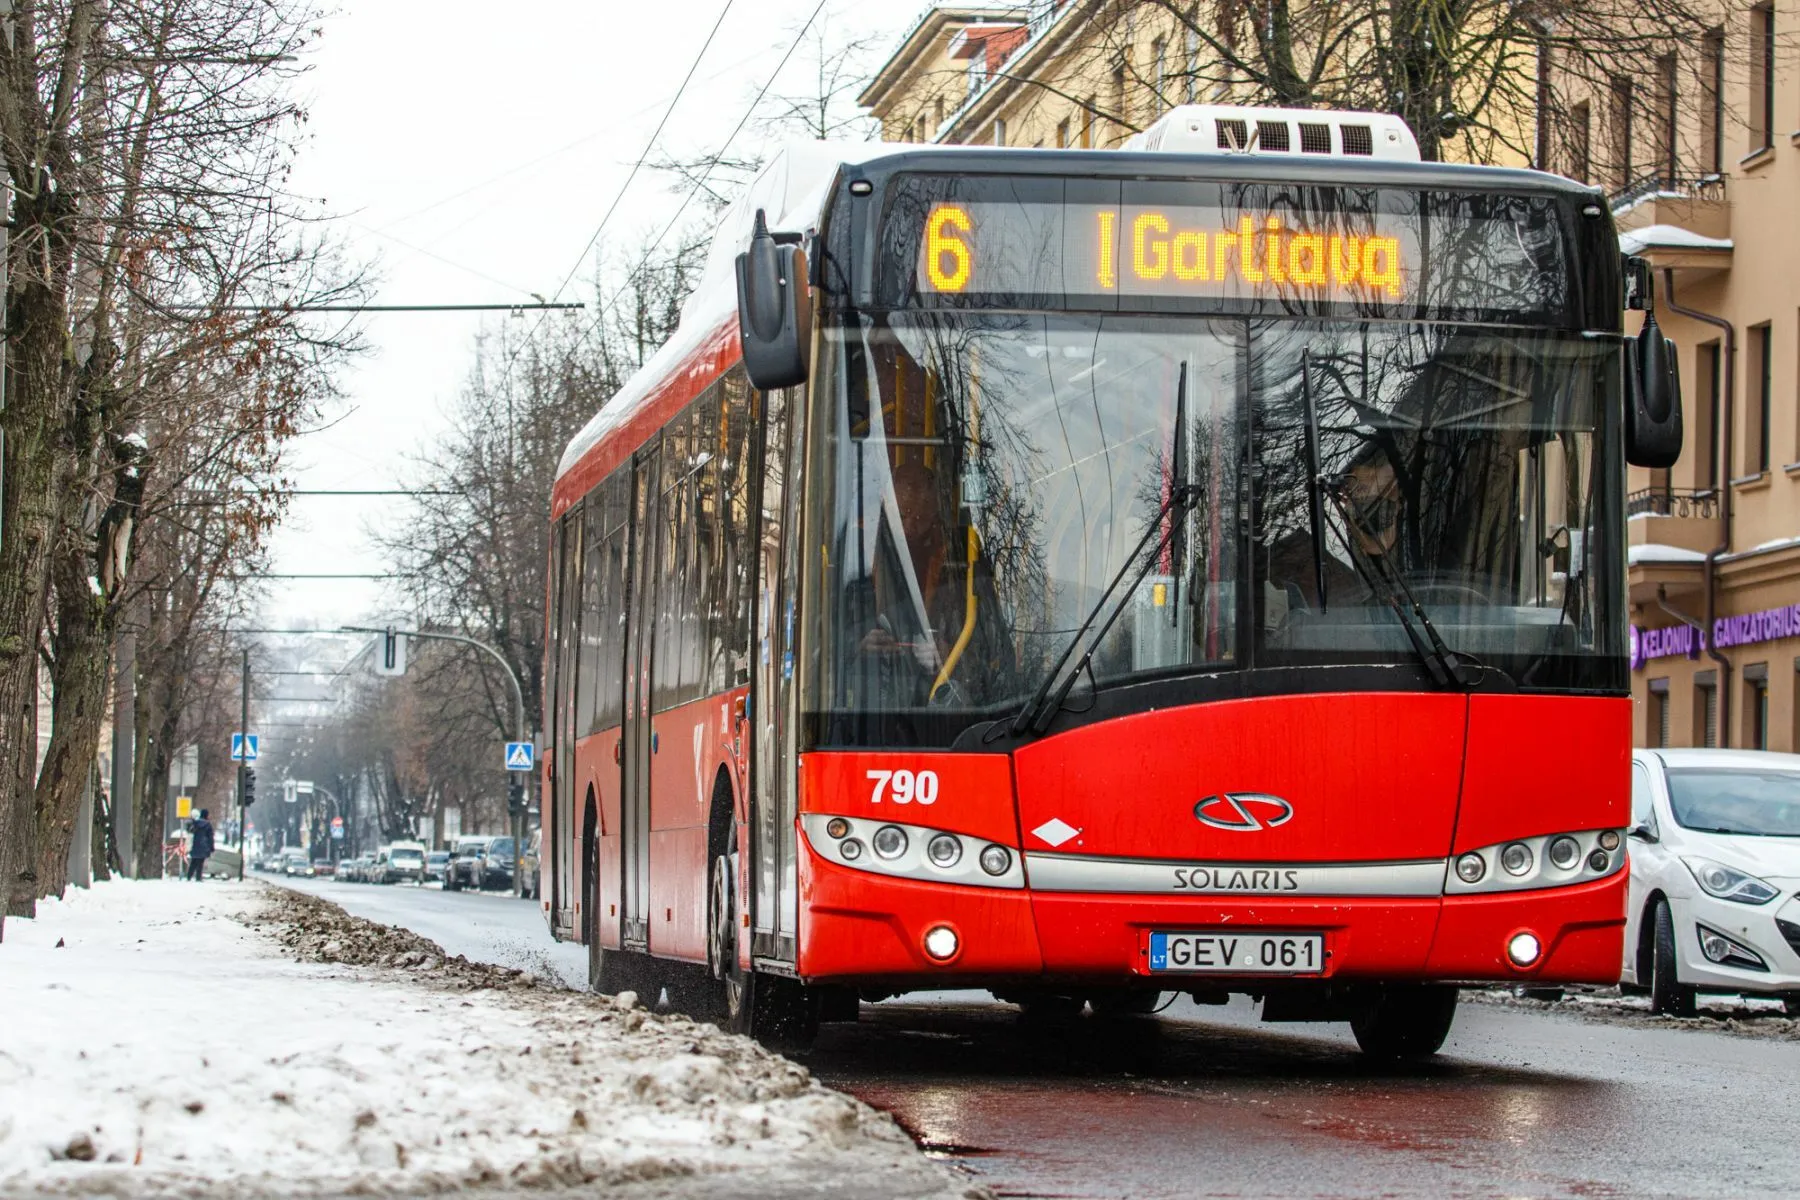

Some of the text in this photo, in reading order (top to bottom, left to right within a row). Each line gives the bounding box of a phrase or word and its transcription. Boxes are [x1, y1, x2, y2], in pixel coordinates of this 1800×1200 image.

[926, 207, 971, 292] 6
[1698, 603, 1800, 651] OGANIZATORIUS
[866, 769, 939, 805] 790
[1173, 868, 1298, 890] SOLARIS
[1152, 955, 1166, 964] LT
[1171, 938, 1313, 967] GEV 061
